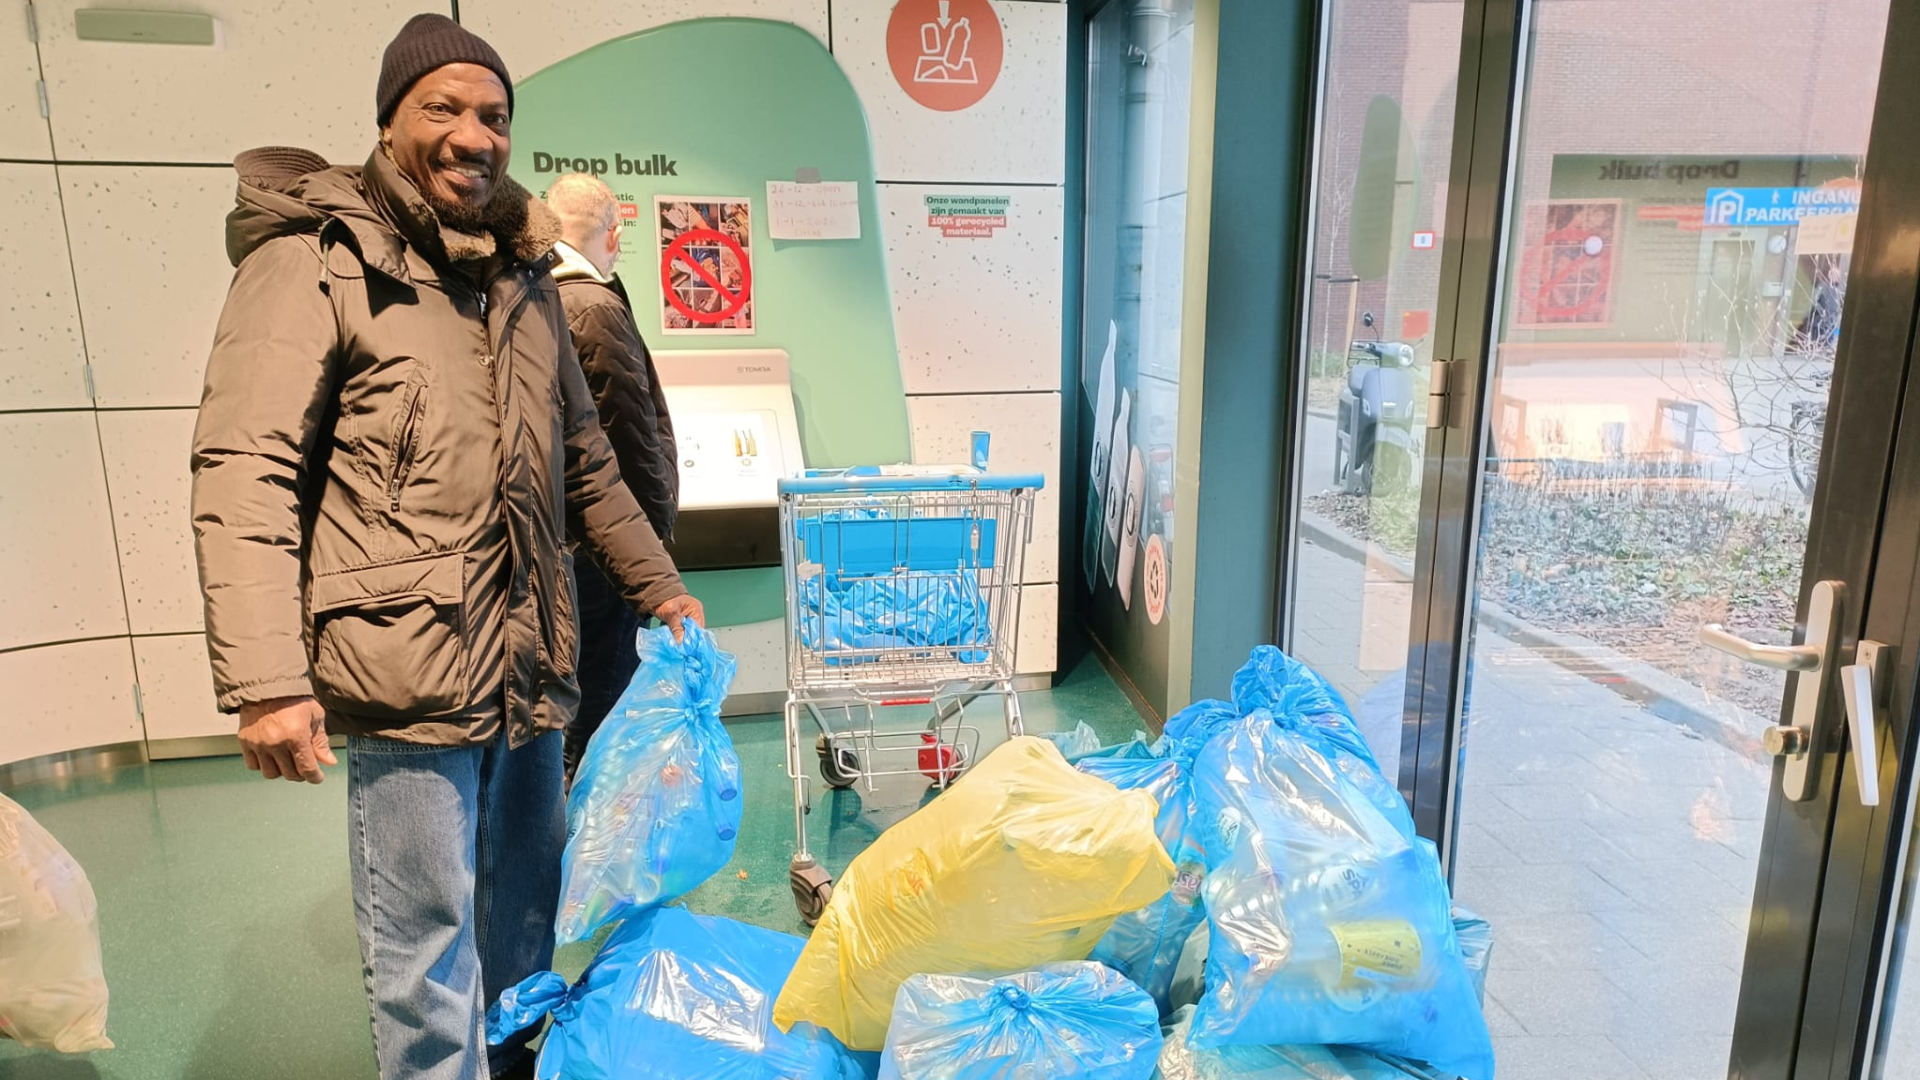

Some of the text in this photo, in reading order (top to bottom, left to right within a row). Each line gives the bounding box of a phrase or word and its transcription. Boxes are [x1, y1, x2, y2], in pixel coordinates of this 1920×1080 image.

[533, 152, 678, 179] Drop bulk
[926, 196, 1009, 206] Onze wandpanelen
[931, 207, 946, 216] zijn
[948, 207, 986, 216] gemaakt
[931, 217, 1004, 227] 100% gerecycled
